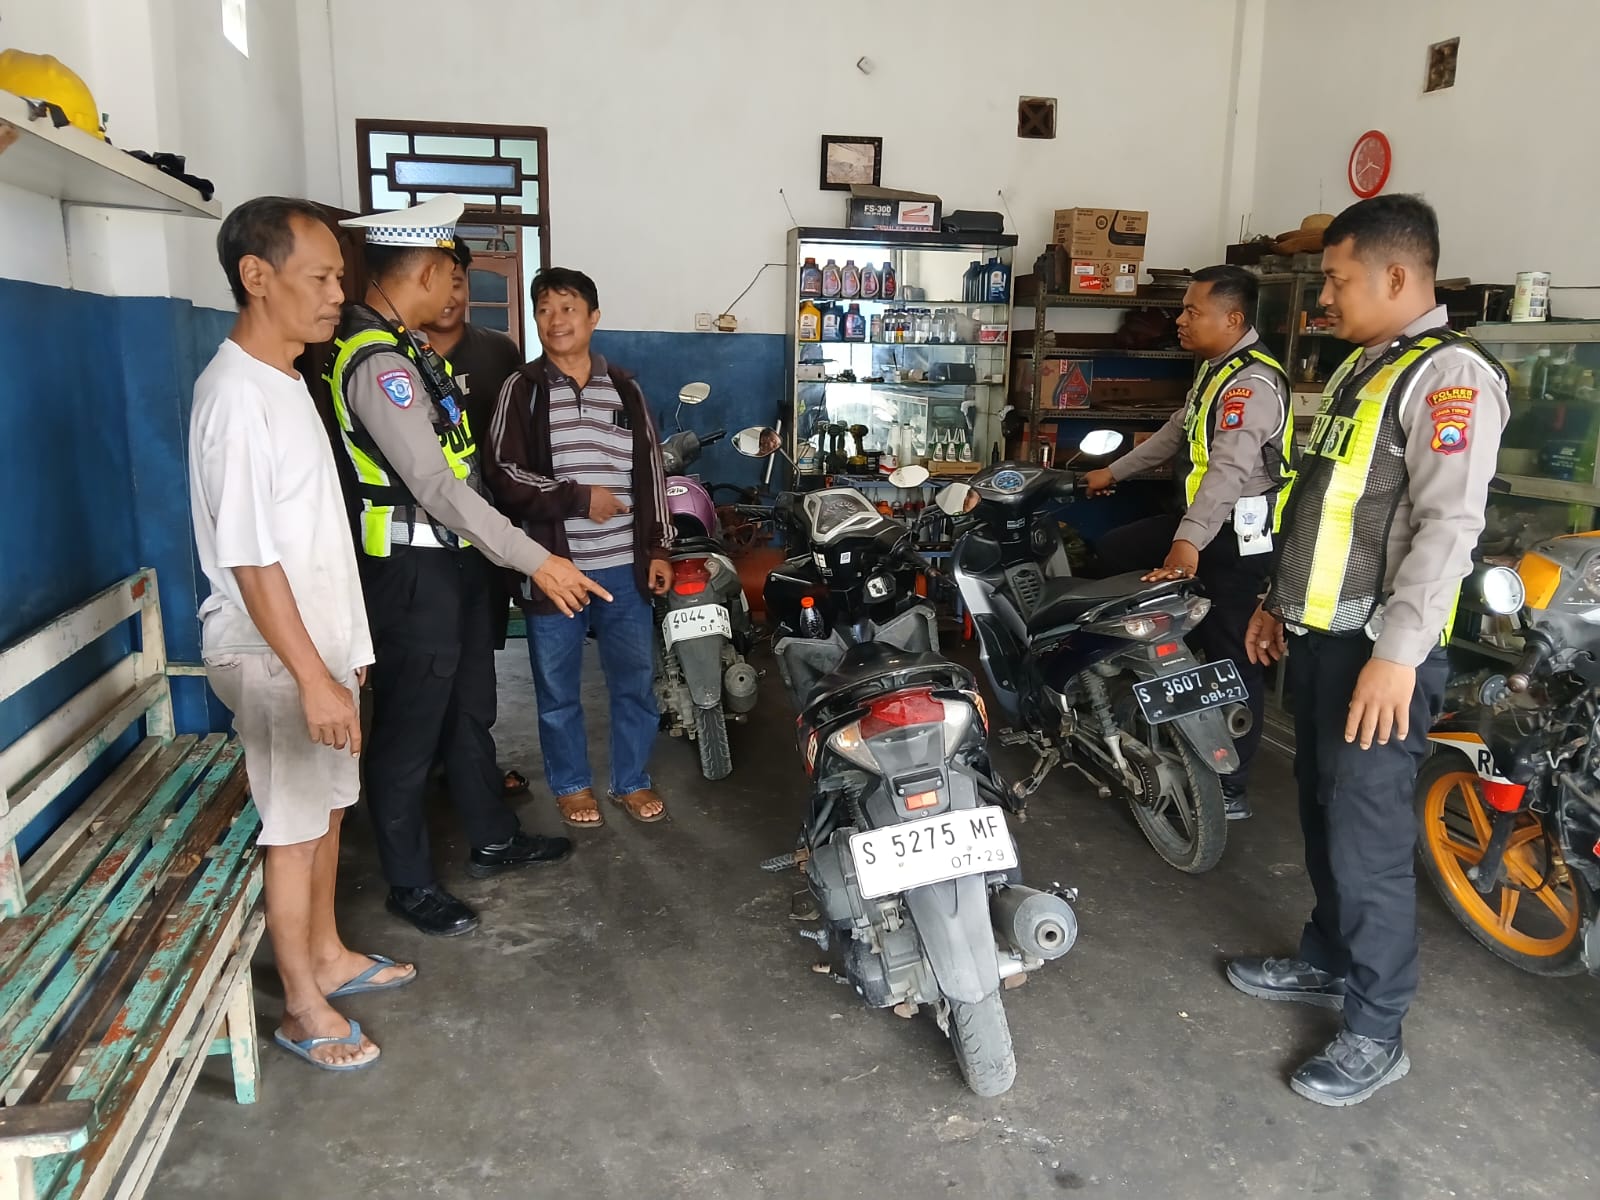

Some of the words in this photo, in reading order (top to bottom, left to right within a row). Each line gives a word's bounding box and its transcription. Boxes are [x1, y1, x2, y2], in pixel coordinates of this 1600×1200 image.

[864, 204, 892, 213] FS-300
[1433, 388, 1473, 401] POLRES
[673, 608, 706, 624] 4044
[1139, 687, 1152, 703] S
[1162, 672, 1203, 697] 3607
[1213, 663, 1236, 683] LJ
[862, 841, 876, 865] S
[891, 822, 956, 858] 5275
[969, 816, 998, 840] MF
